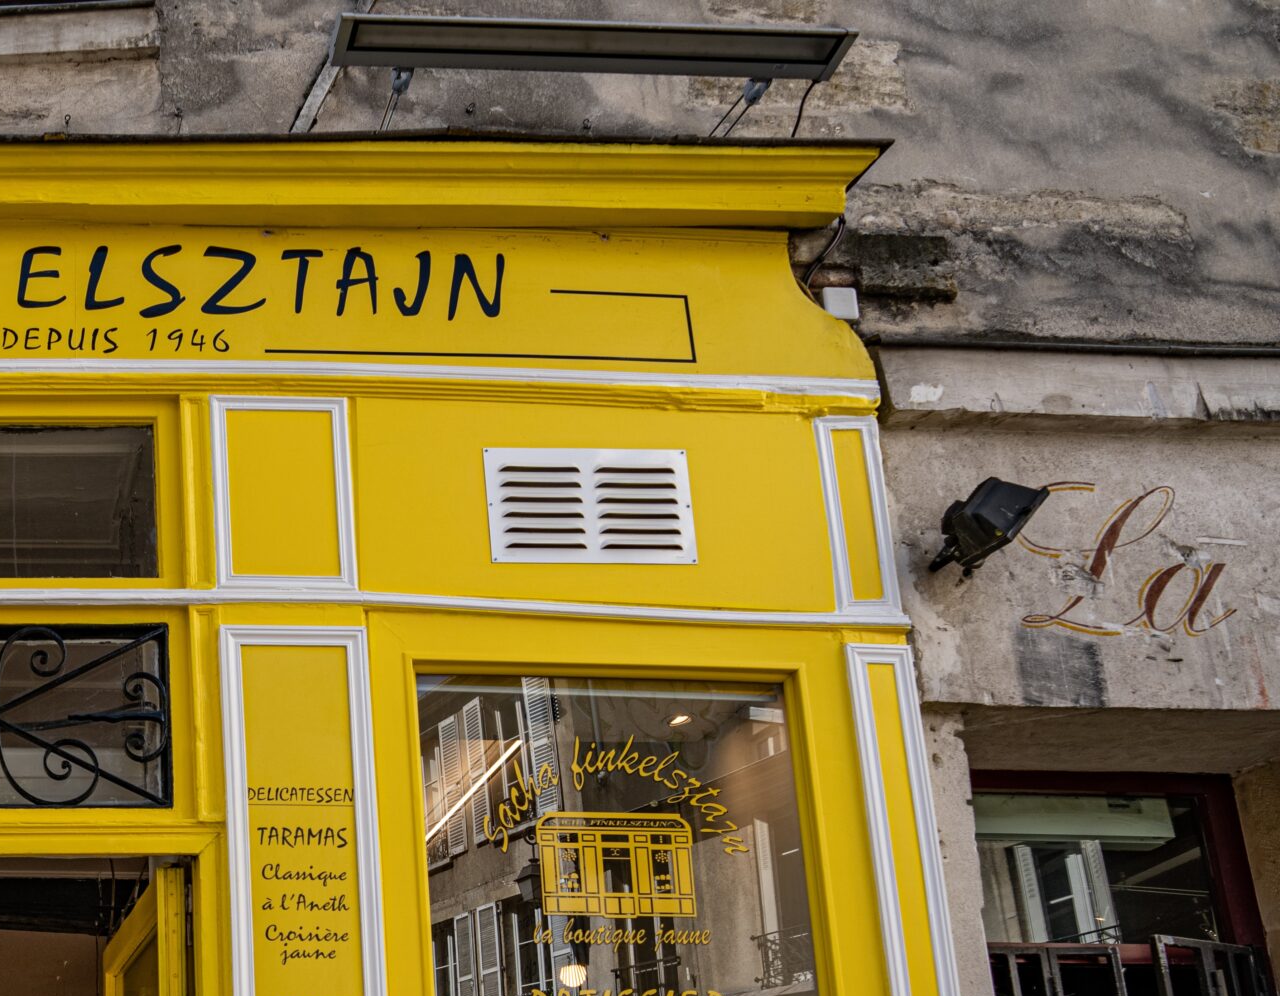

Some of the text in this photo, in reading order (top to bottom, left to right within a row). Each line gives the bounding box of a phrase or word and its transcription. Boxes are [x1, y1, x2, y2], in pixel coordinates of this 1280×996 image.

[2, 326, 120, 354] DEPUIS
[146, 328, 230, 353] 1946
[247, 786, 355, 804] DELICATESSEN
[256, 826, 348, 848] TARAMAS
[261, 863, 348, 887] Classique
[261, 897, 274, 911] à
[264, 924, 349, 942] Croisière
[532, 917, 712, 952] la boutique jaune
[280, 942, 337, 965] jaune
